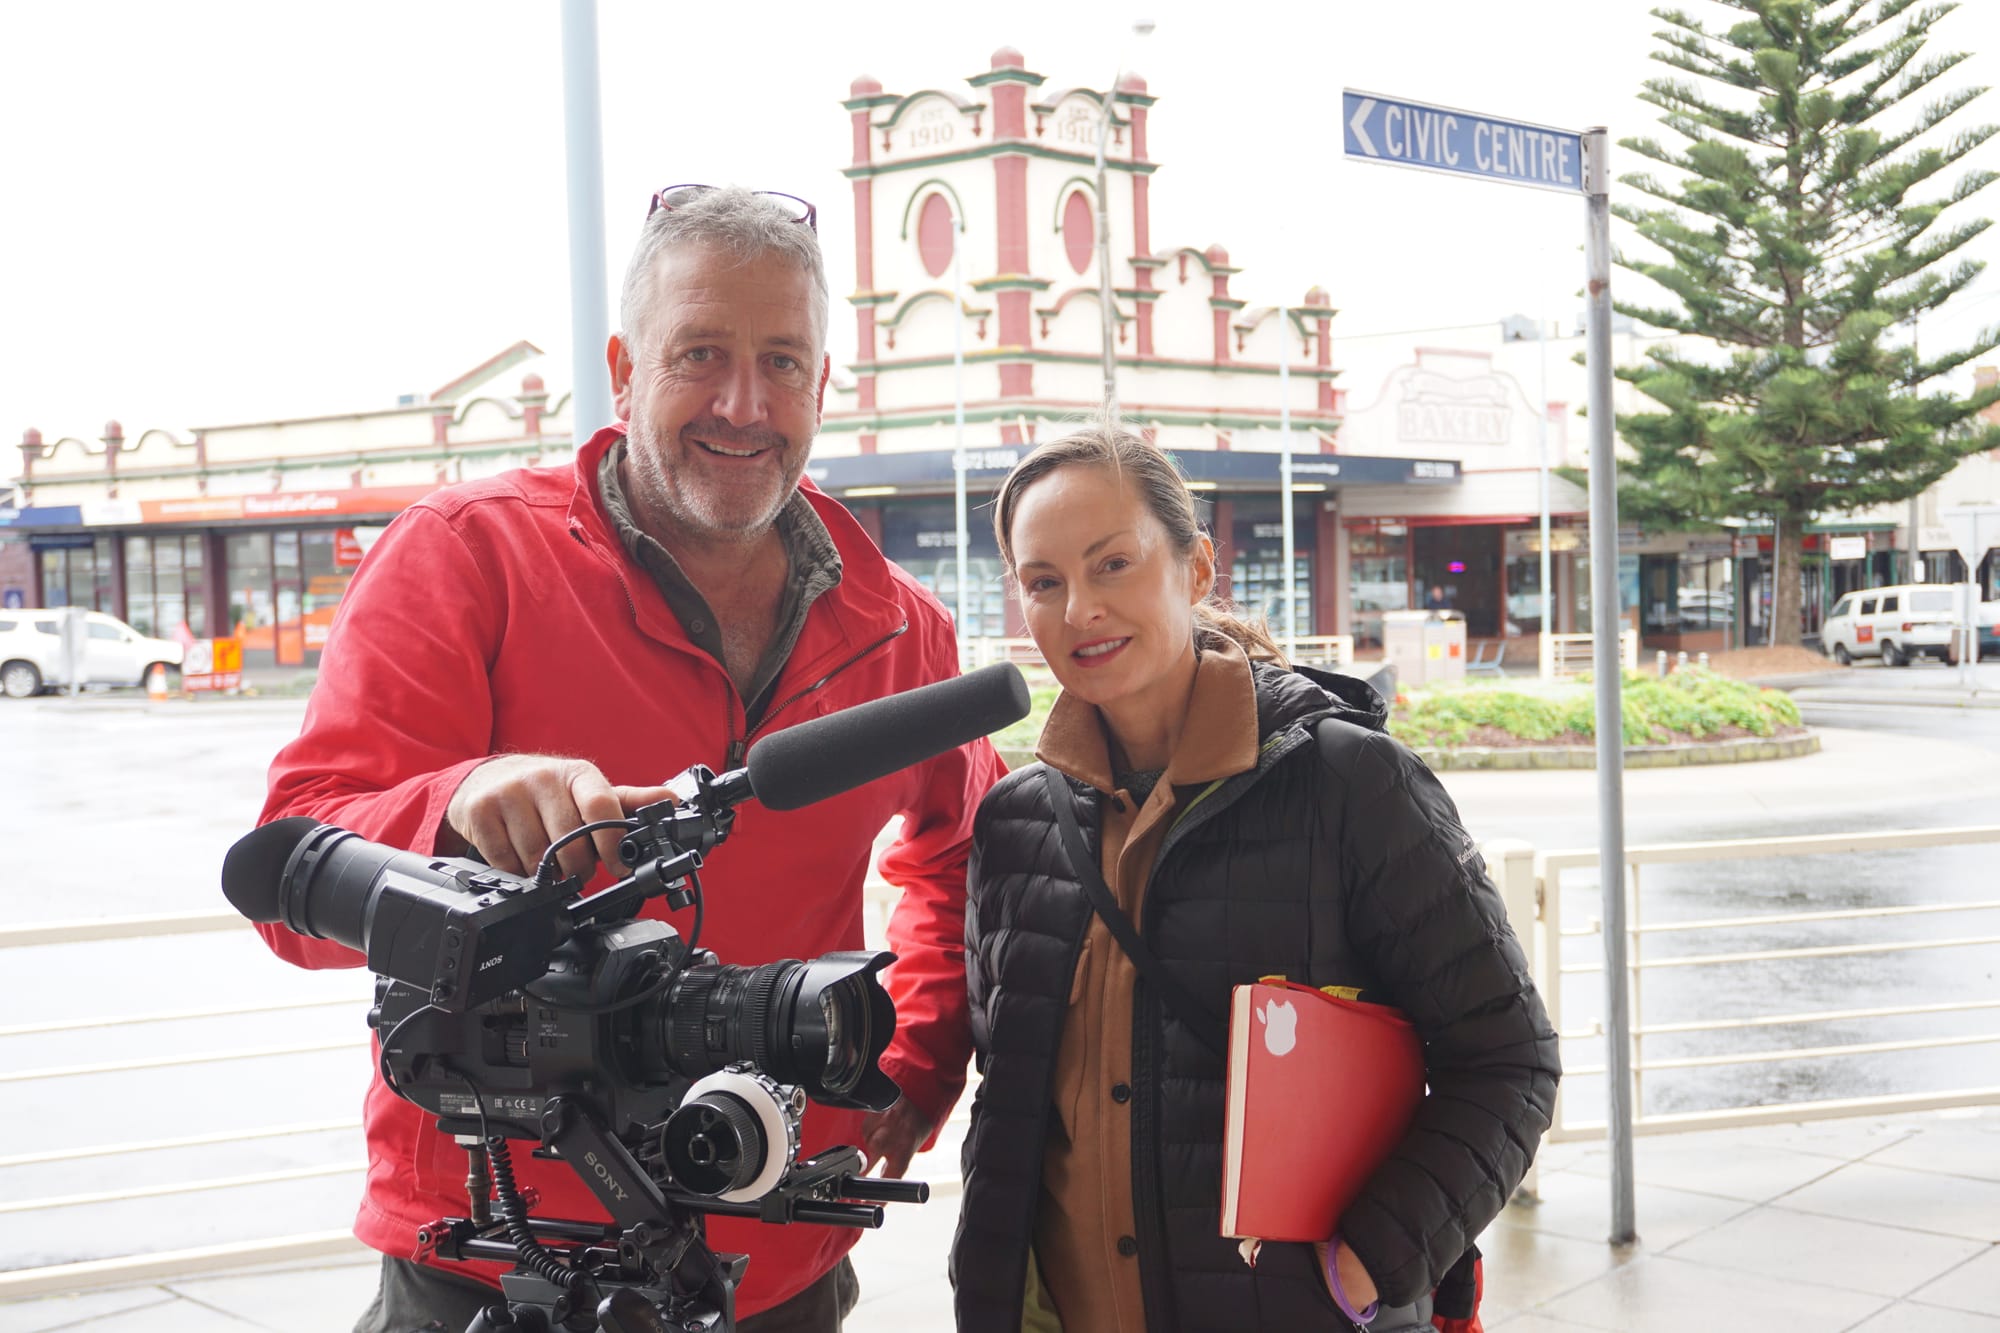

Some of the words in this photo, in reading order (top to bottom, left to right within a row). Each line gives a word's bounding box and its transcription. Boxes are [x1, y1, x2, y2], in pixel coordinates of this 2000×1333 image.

[909, 123, 954, 148] 1910
[1385, 104, 1459, 166] CIVIC
[1473, 121, 1574, 184] CENTRE
[1402, 407, 1505, 440] BAKERY
[480, 955, 503, 971] SONY
[584, 1151, 630, 1201] SONY
